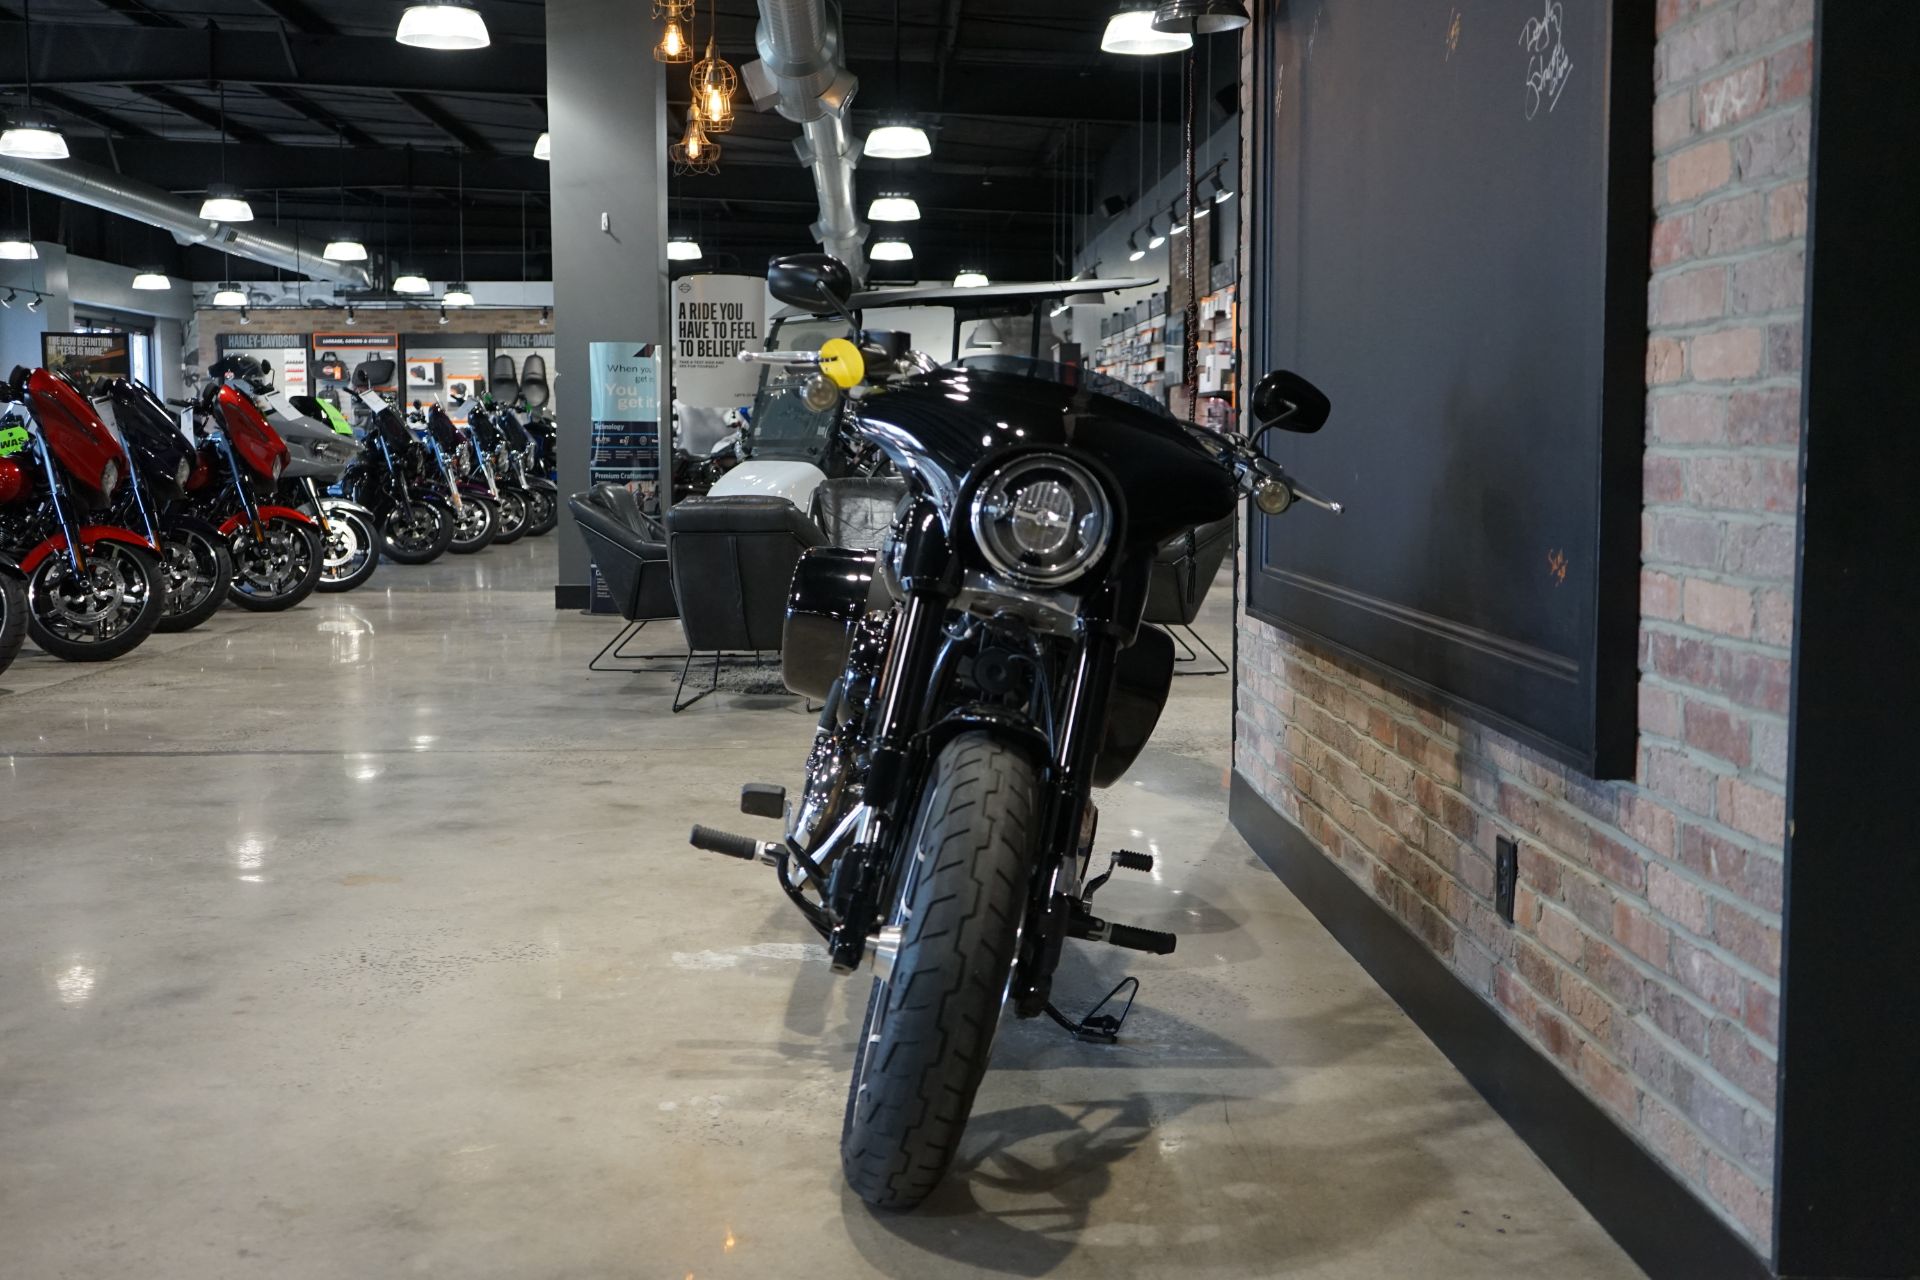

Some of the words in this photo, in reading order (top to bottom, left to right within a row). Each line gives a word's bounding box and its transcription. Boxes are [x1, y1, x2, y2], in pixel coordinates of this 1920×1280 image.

[679, 302, 686, 320] A
[690, 303, 717, 320] RIDE
[720, 303, 743, 320] YOU
[679, 321, 709, 338] HAVE
[712, 322, 728, 338] TO
[730, 322, 758, 339] FEEL
[228, 335, 300, 348] HARLEY-DAVIDSON
[678, 340, 694, 357] TO
[607, 364, 638, 373] When
[605, 384, 637, 396] You
[618, 396, 644, 410] get
[0, 437, 25, 449] WAS
